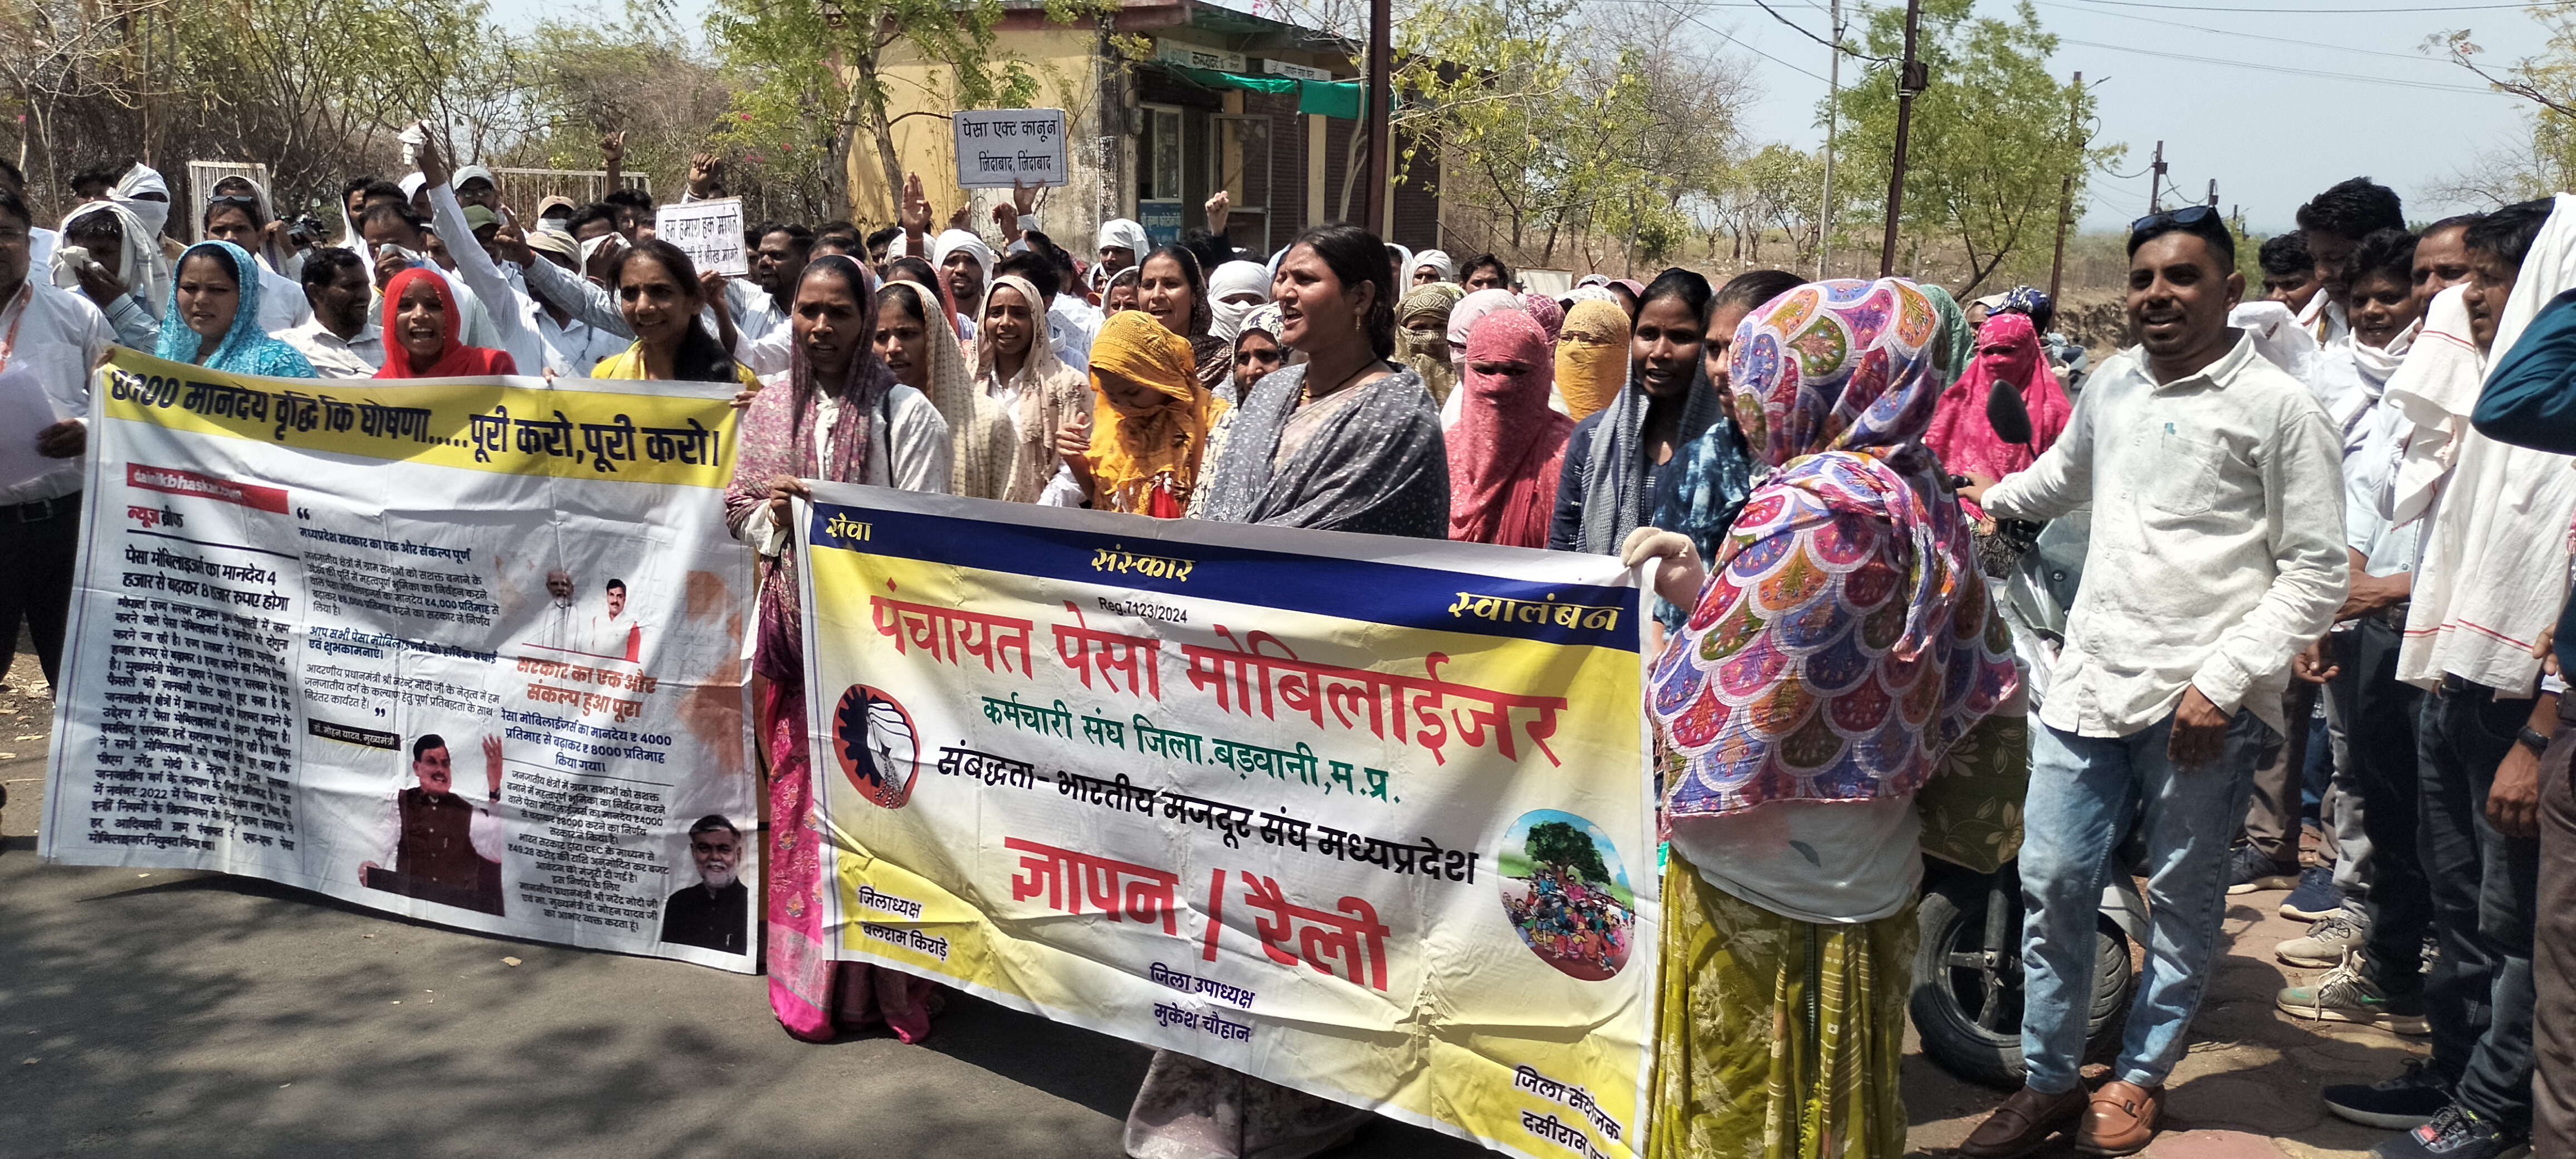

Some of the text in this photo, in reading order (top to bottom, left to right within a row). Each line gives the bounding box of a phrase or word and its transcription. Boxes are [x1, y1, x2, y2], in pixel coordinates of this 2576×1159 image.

[963, 118, 1057, 142] पेसा एक्ट कानून
[979, 149, 1051, 174] जिंदाबाद, जिंदाबाद
[665, 219, 676, 241] हम
[702, 217, 714, 238] हक
[705, 244, 720, 264] भीख
[183, 380, 269, 422] मानदेय
[275, 391, 317, 440] वृद्धि
[322, 395, 354, 432] कि
[299, 527, 471, 564] मध्यप्रदेश सरकार का एक और संकल्प पूर्ण
[825, 512, 873, 543] सेवा
[125, 544, 149, 566] पेसा
[205, 562, 221, 578] का
[222, 563, 266, 584] मानदेय
[267, 571, 276, 586] 4
[363, 562, 379, 573] ग्राम
[406, 567, 417, 578] को
[419, 571, 444, 581] सशक्त
[445, 573, 471, 585] बनाने
[471, 574, 482, 585] के
[1091, 544, 1196, 583] संस्कार
[123, 572, 152, 588] हजार
[155, 571, 165, 591] से
[201, 583, 209, 597] 8
[210, 585, 231, 603] हजार
[233, 590, 261, 608] रुपए
[262, 590, 290, 612] होगा
[394, 593, 423, 605] मानदेय
[458, 600, 490, 615] प्रतिमाह
[491, 603, 500, 615] से
[1098, 597, 1188, 625] Reg.7123/2024
[1448, 591, 1624, 631] स्वालंबन
[309, 637, 384, 659] एवं शुभकामनाएं।
[310, 626, 329, 637] आप
[329, 627, 350, 641] सभी
[352, 629, 370, 644] पेसा
[306, 664, 343, 677] आदरणीय
[344, 669, 381, 683] प्रधानमंत्री
[383, 673, 392, 685] श्री
[414, 679, 432, 691] मोदी
[434, 682, 444, 694] जी
[446, 684, 456, 695] के
[456, 685, 479, 702] नेतृत्व
[480, 690, 488, 702] में
[488, 693, 500, 704] हम
[517, 656, 657, 694] सरकार का एक और
[870, 577, 1568, 768] पंचायत पेसा मोबिलाईजर
[105, 691, 152, 705] जनजातीय
[284, 714, 292, 728] के
[304, 688, 329, 703] निरंतर
[331, 695, 360, 708] कार्यरत
[305, 677, 345, 691] जनजातीय
[347, 681, 360, 693] वर्ग
[361, 684, 370, 694] के
[402, 690, 413, 705] हेतु
[414, 694, 429, 707] पूर्ण
[430, 695, 466, 712] प्रतिबद्धता
[467, 702, 476, 713] के
[477, 705, 493, 717] साथ
[527, 679, 642, 723] संकल्प हुआ पूरा
[323, 725, 341, 737] मोहन
[519, 710, 578, 733] मोबिलाईजर्स
[578, 724, 589, 736] का
[591, 727, 627, 742] मानदेय
[631, 732, 637, 742] ₹
[640, 733, 672, 746] 4000
[981, 691, 1073, 741] कर्मचारी
[1081, 707, 1125, 750] संघ
[505, 725, 542, 744] प्रतिमाह
[543, 731, 553, 746] से
[583, 742, 589, 754] ₹
[591, 744, 621, 757] 8000
[623, 746, 665, 764] प्रतिमाह
[555, 752, 606, 772] किया गया।
[94, 782, 104, 795] में
[140, 788, 167, 799] 2022
[171, 787, 180, 799] में
[512, 770, 545, 785] जनजातीय
[546, 776, 561, 788] क्षेत्रों
[570, 783, 588, 792] ग्राम
[590, 785, 618, 796] सभाओं
[619, 787, 632, 798] को
[1057, 773, 1156, 817] भारतीय
[1162, 791, 1251, 850] मजदूर
[1258, 806, 1307, 852] संघ
[1316, 825, 1480, 884] मध्यप्रदेश
[859, 886, 921, 918] जिलाध्यक्ष
[1003, 836, 1179, 937] ज्ञापन
[1241, 870, 1391, 991] रैली
[910, 930, 948, 961] किराड़े
[1149, 961, 1256, 1009] जिला उपाध्यक्ष
[1153, 1001, 1251, 1044] मुकेश चौहान
[1515, 1065, 1621, 1140] जिला संयोजक
[1522, 1111, 1588, 1155] दसीराम
